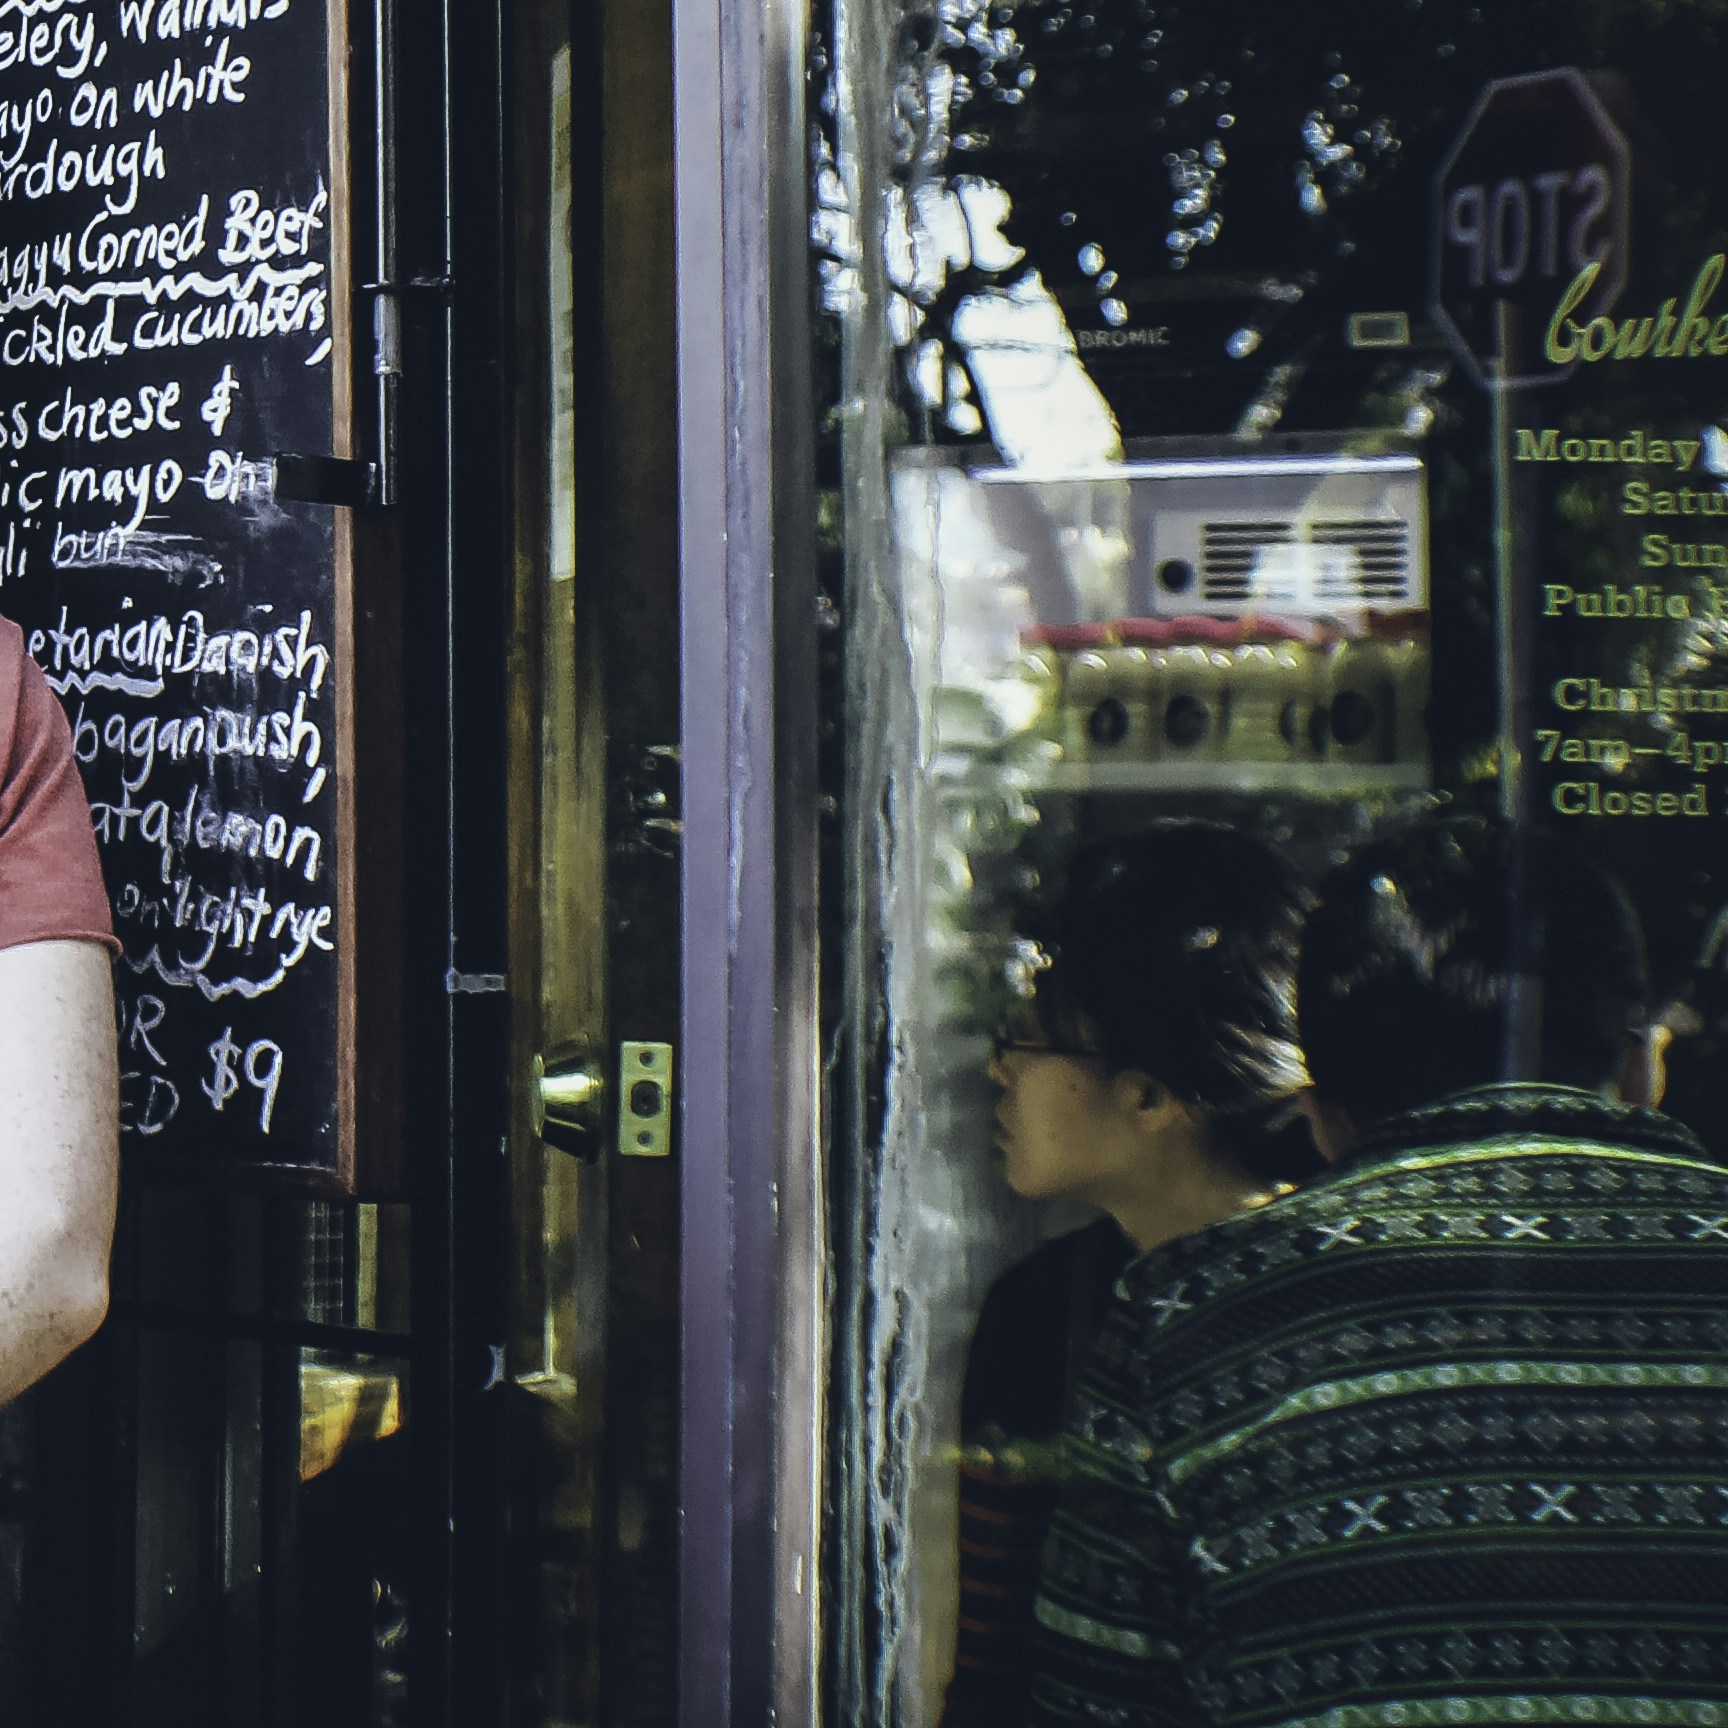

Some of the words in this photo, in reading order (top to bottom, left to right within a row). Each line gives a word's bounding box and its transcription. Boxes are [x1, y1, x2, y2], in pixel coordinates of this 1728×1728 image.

[133, 38, 252, 114] white
[77, 193, 209, 274] Corned
[217, 189, 328, 267] Beef
[37, 381, 182, 444] cheese
[1513, 428, 1701, 472] Monday
[55, 458, 184, 534] mayo
[1551, 781, 1711, 817] Closed
[201, 1025, 284, 1135] $9
